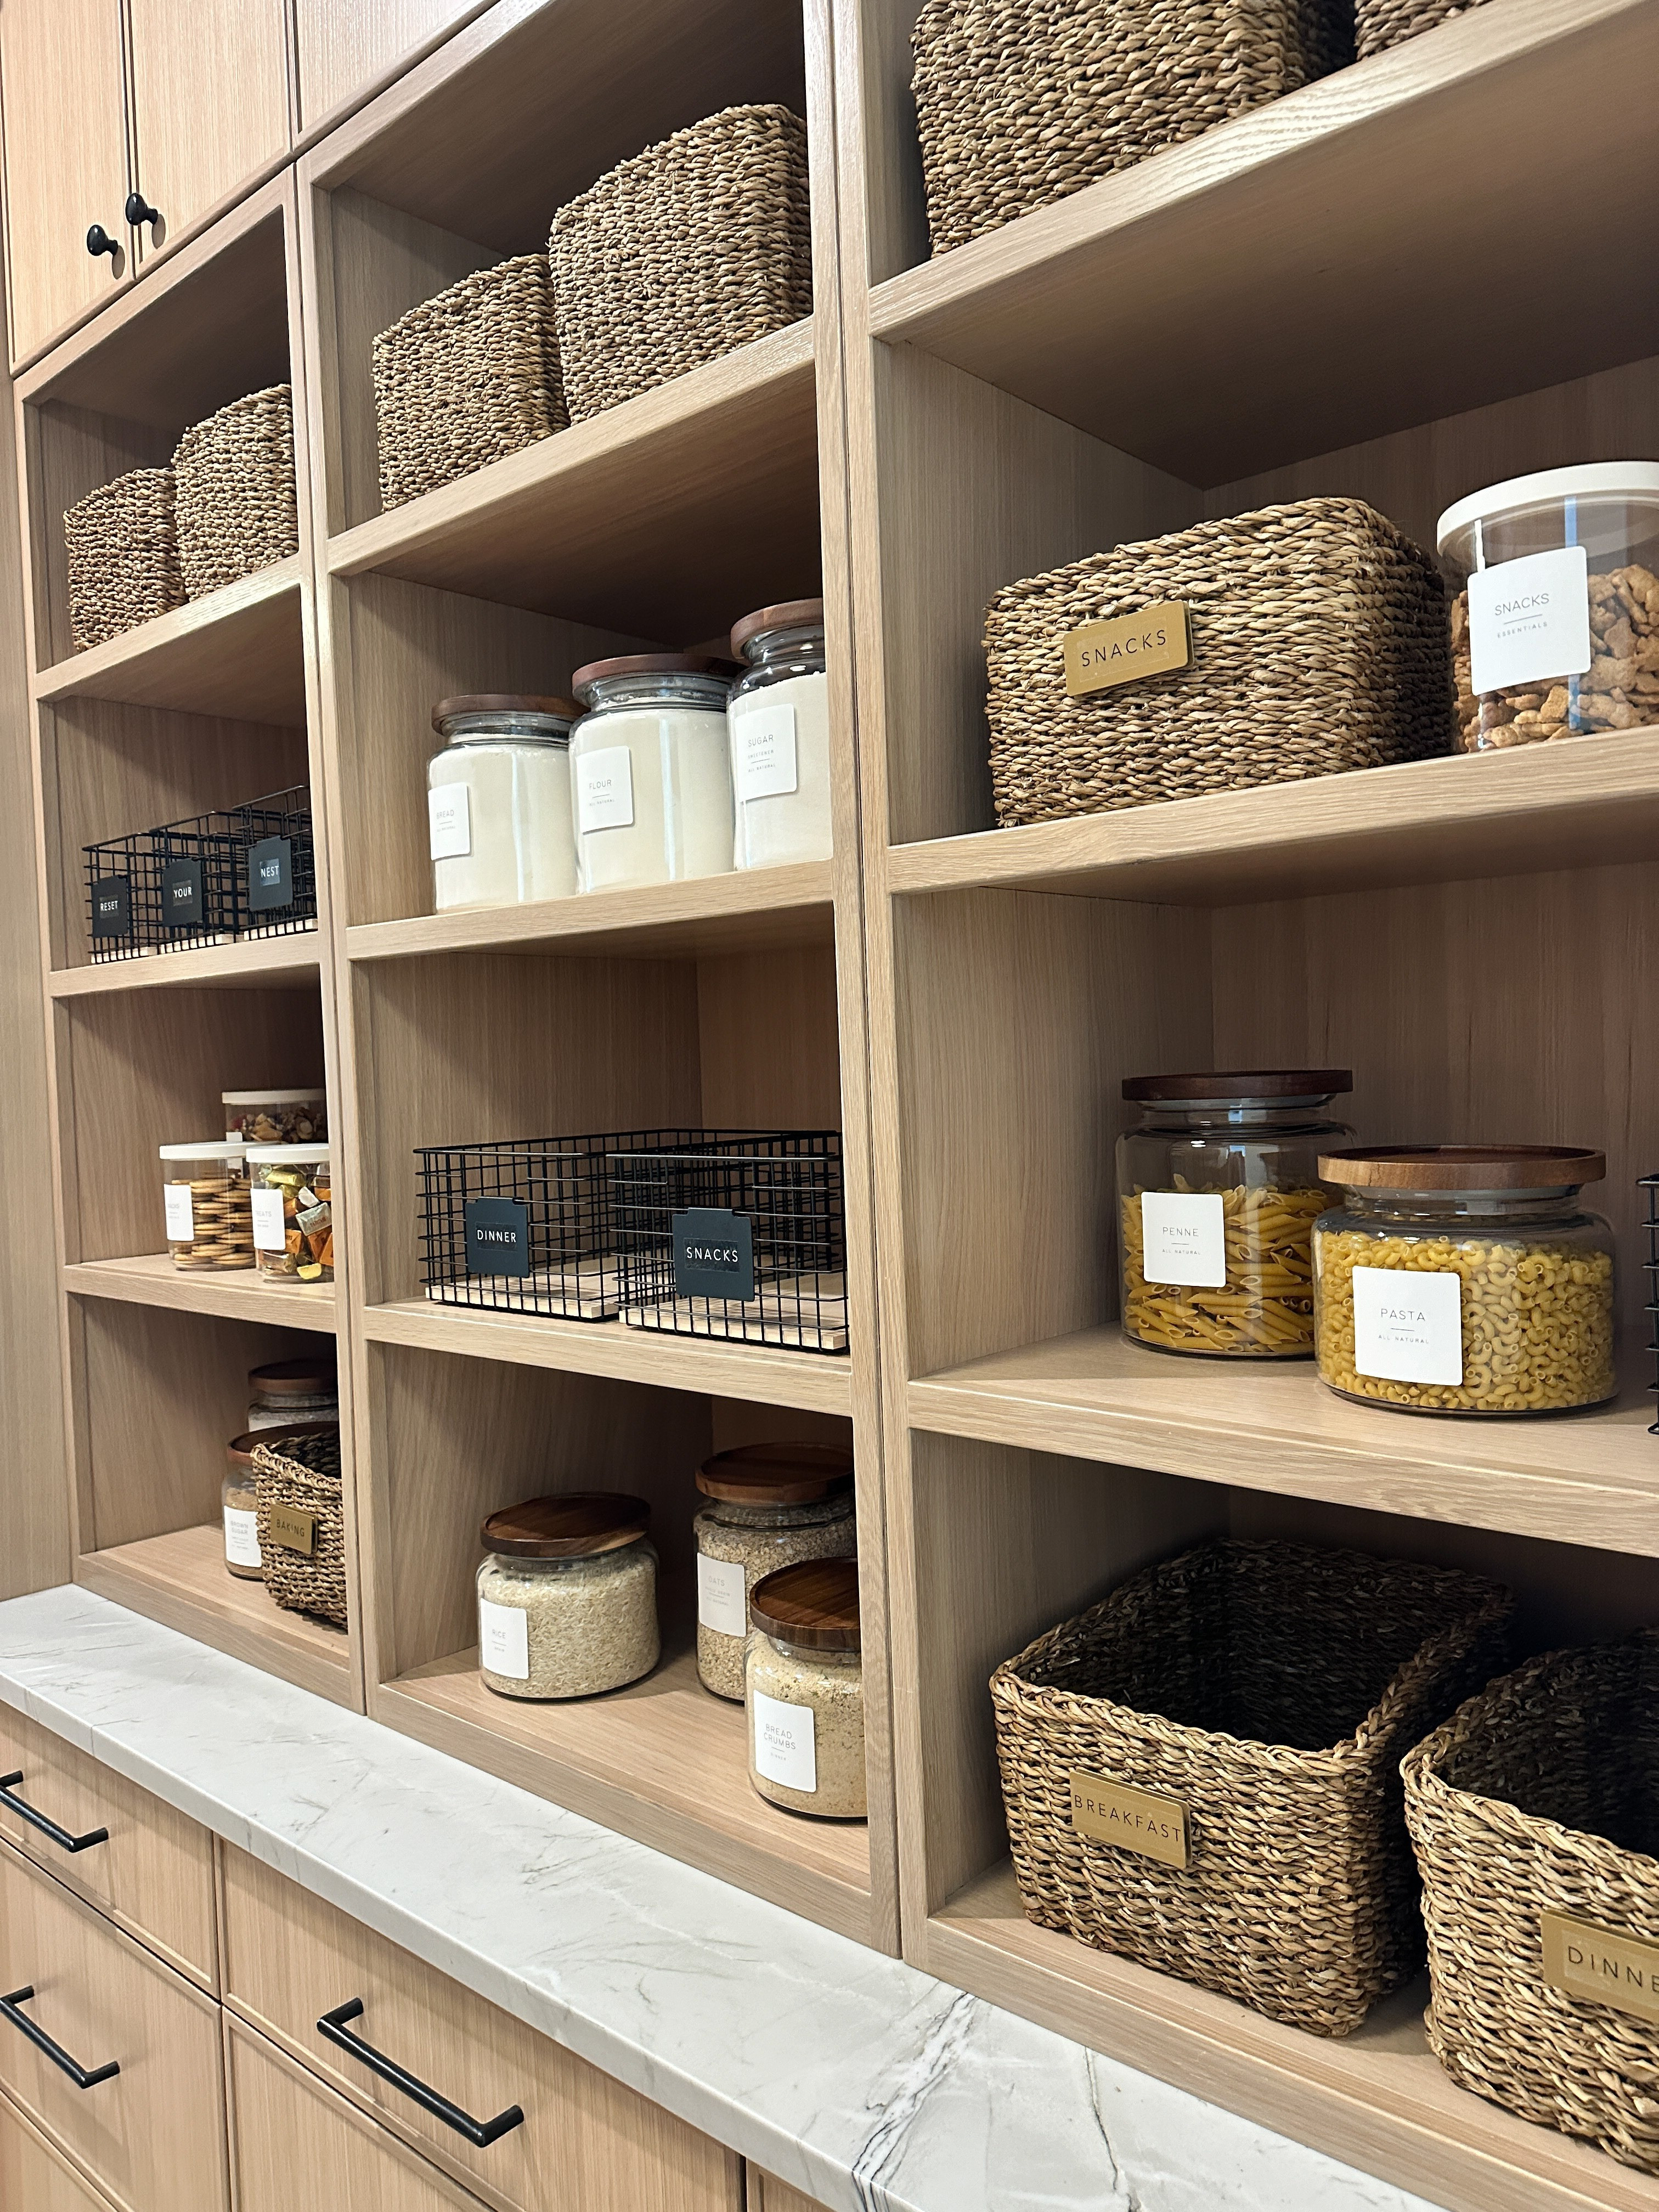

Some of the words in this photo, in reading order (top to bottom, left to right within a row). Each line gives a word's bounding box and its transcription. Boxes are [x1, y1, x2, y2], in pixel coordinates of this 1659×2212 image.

[1494, 592, 1550, 616] SNACKS
[1497, 621, 1548, 638] ESSENTIALS
[1081, 629, 1166, 667] SNACKS
[748, 734, 774, 747] SUGAR
[589, 779, 612, 789] FLOUR
[436, 809, 455, 820] BREAD
[261, 865, 279, 877] NEST
[173, 886, 192, 898] YOUR
[100, 900, 119, 912] RESET
[476, 1229, 517, 1243] DINNER
[1163, 1227, 1199, 1237] PENNE
[686, 1246, 739, 1263] SNACKS
[1380, 1308, 1426, 1322] PASTA
[1395, 1336, 1430, 1344] NATURAL
[276, 1518, 305, 1537] BAKING
[708, 1575, 725, 1587] OATS
[492, 1629, 506, 1639] RICE
[765, 1723, 792, 1739] BREAD
[764, 1732, 796, 1750] CRUMBS
[1074, 1795, 1181, 1842] BREAKFAST
